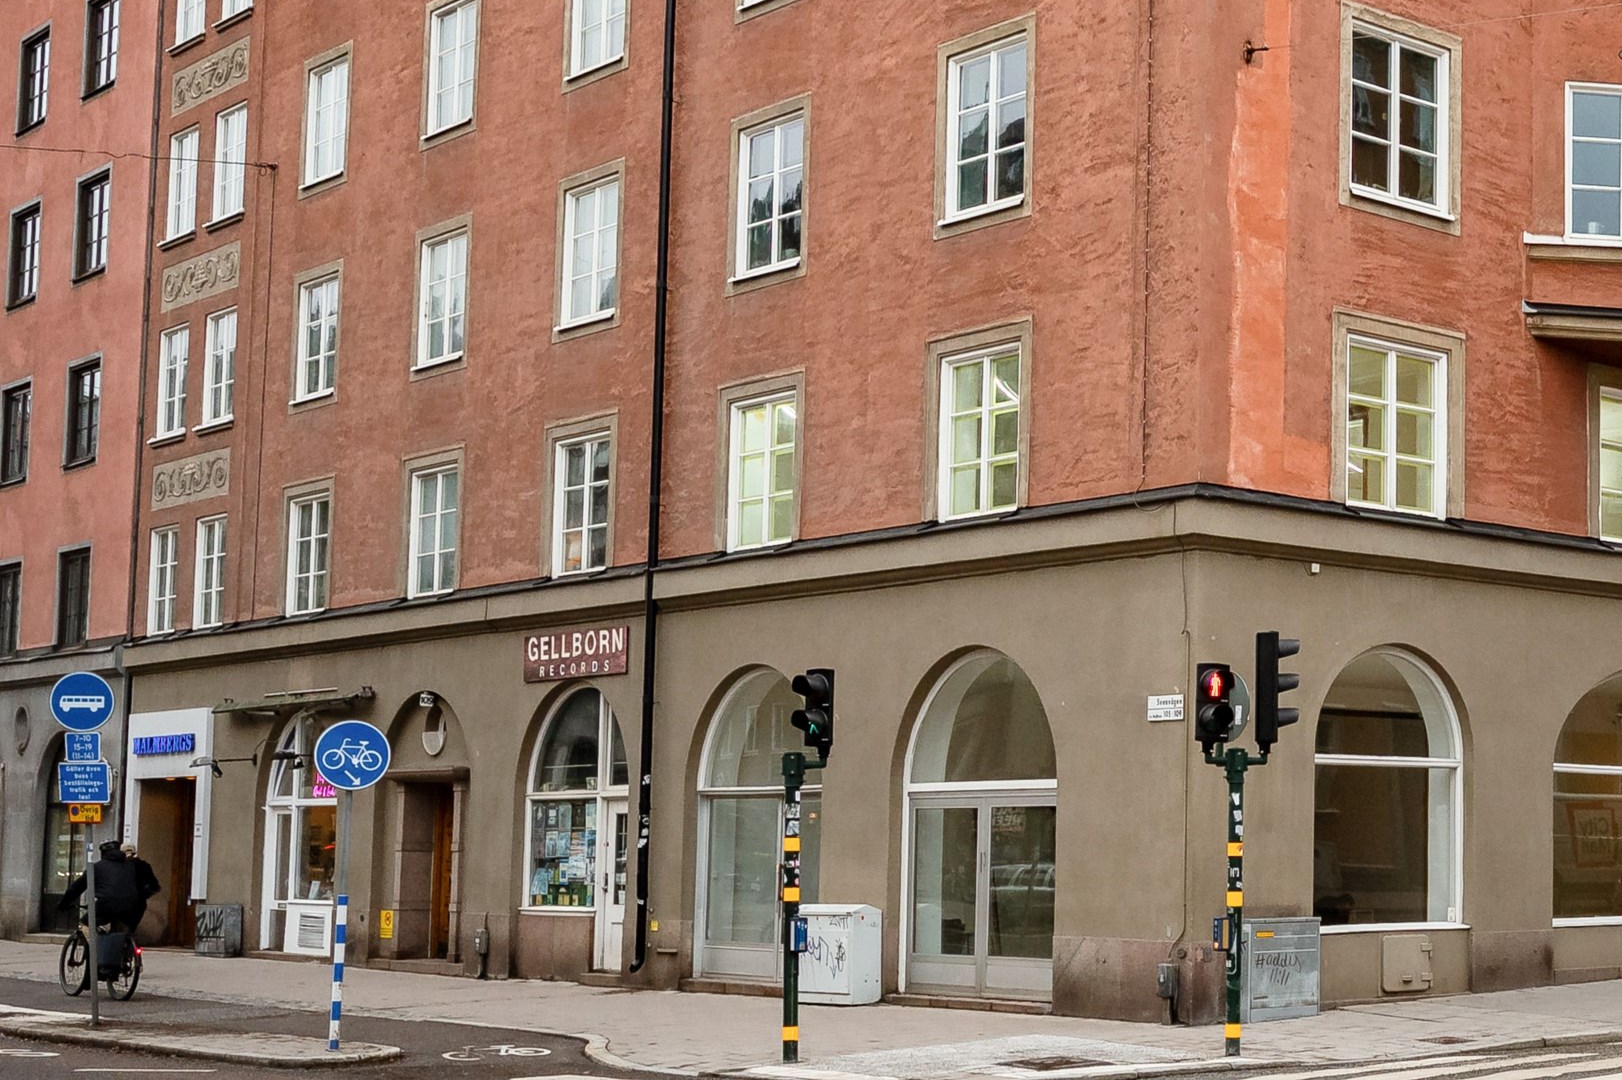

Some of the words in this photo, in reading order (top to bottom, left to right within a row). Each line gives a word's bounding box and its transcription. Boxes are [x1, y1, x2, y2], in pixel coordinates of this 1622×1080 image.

[528, 627, 623, 661] GELLBORN
[539, 660, 609, 677] RECORDS
[73, 743, 93, 751] 15-19
[133, 733, 195, 754] MALMBERGS
